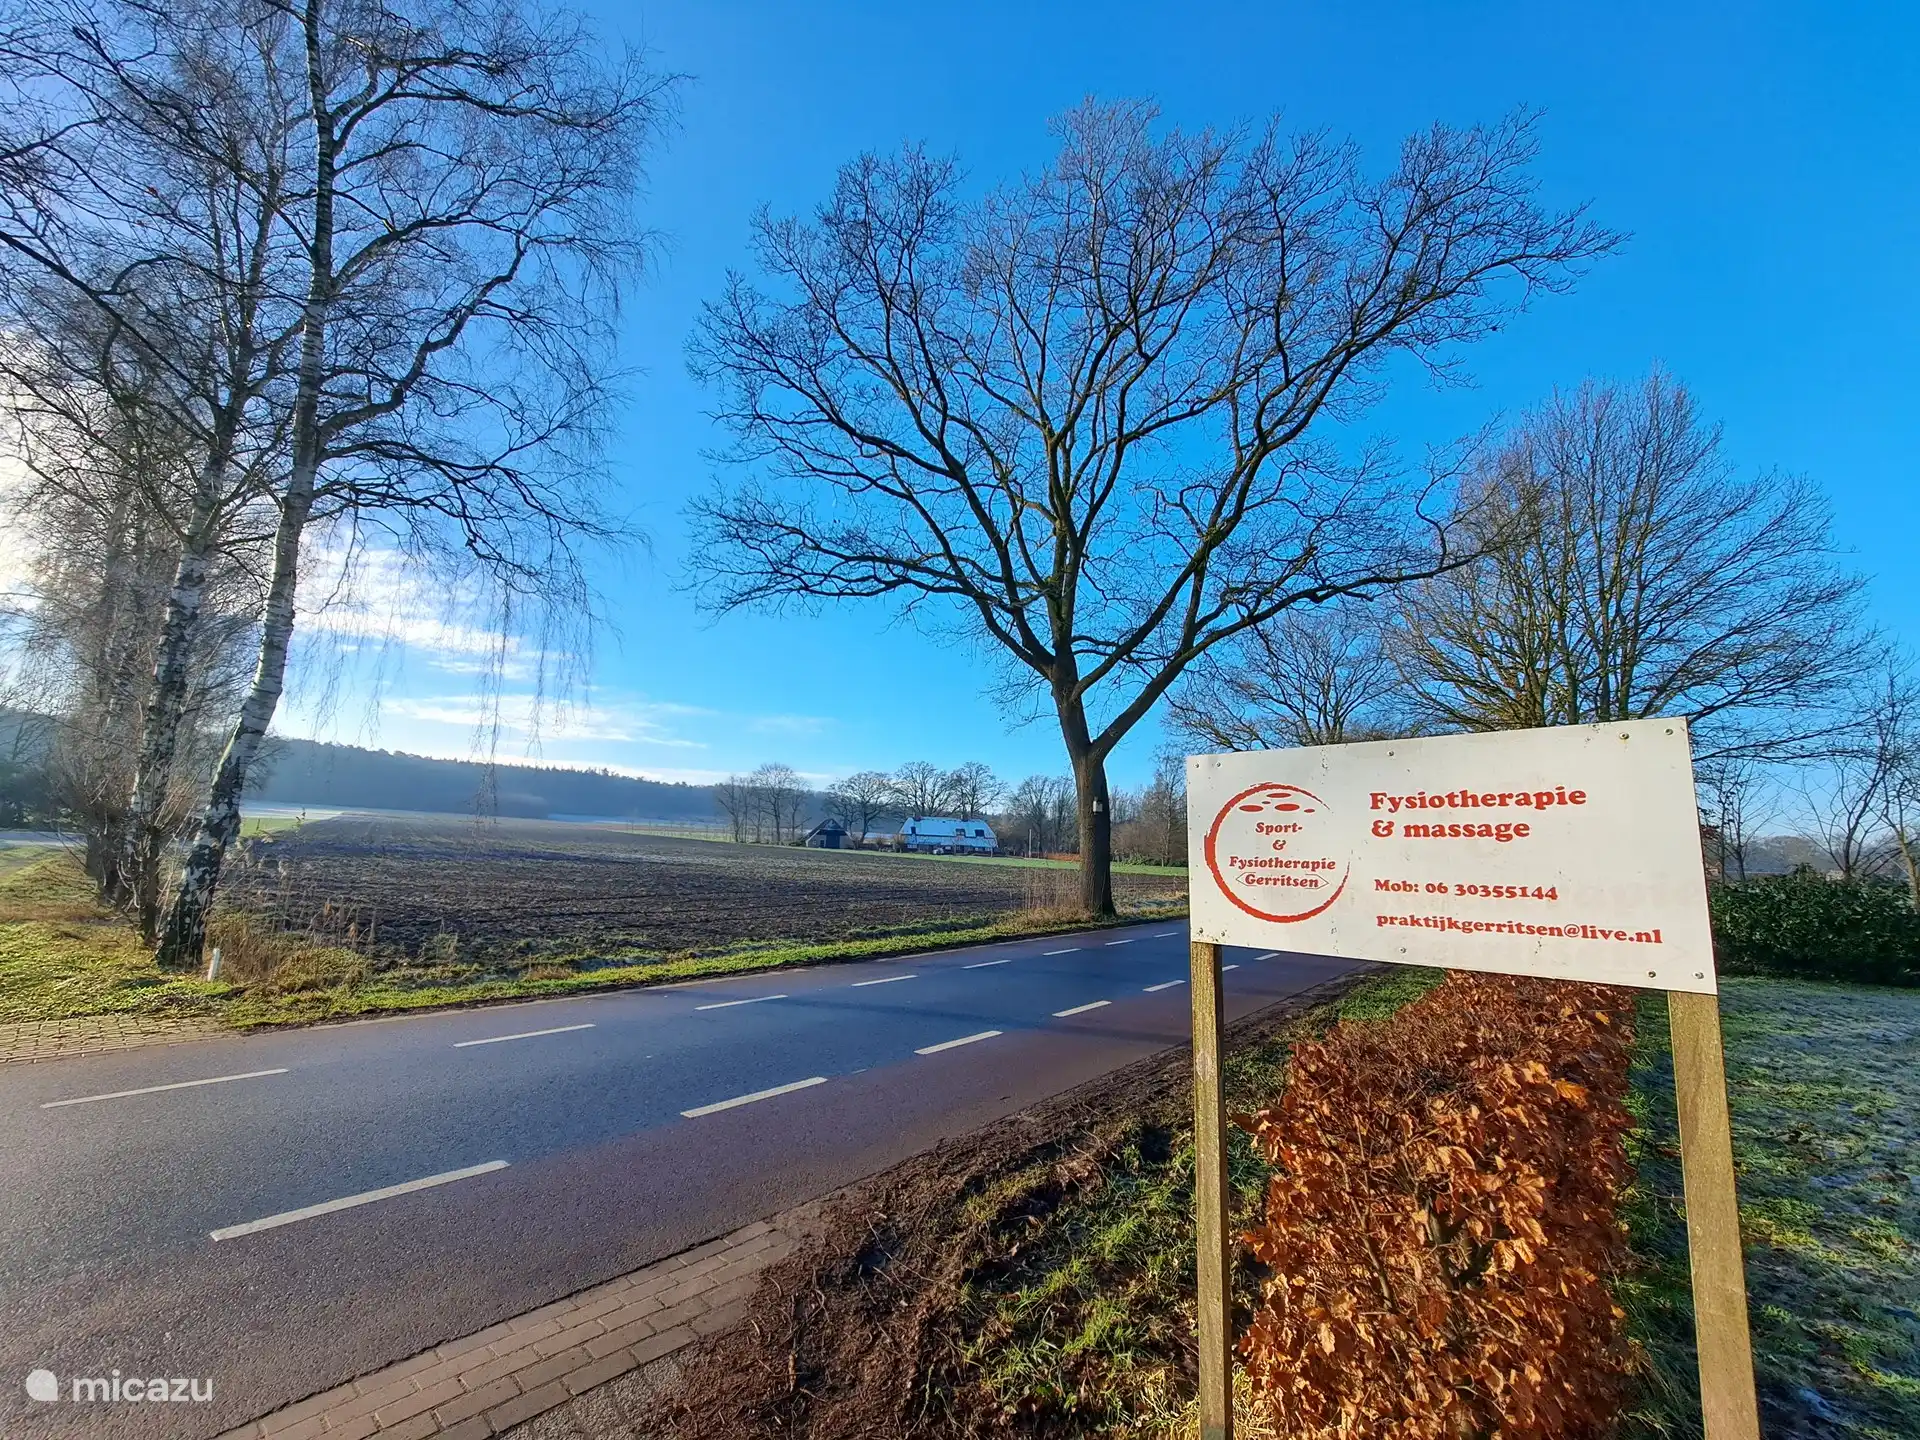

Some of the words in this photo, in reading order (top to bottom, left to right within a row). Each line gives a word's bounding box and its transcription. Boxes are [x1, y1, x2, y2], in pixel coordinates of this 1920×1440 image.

[1370, 786, 1586, 812] Fysiotherapie
[1255, 822, 1302, 836] Sport-
[1371, 819, 1395, 839] &
[1403, 821, 1530, 842] massage
[1272, 840, 1286, 851] &
[1229, 856, 1336, 872] Fysiotherapie
[1245, 874, 1319, 889] Gerritsen
[1374, 879, 1420, 893] Mob:
[1425, 882, 1448, 895] 06
[1454, 883, 1559, 901] 30355144
[1376, 914, 1663, 944] praktijkgerritsen@live.nl
